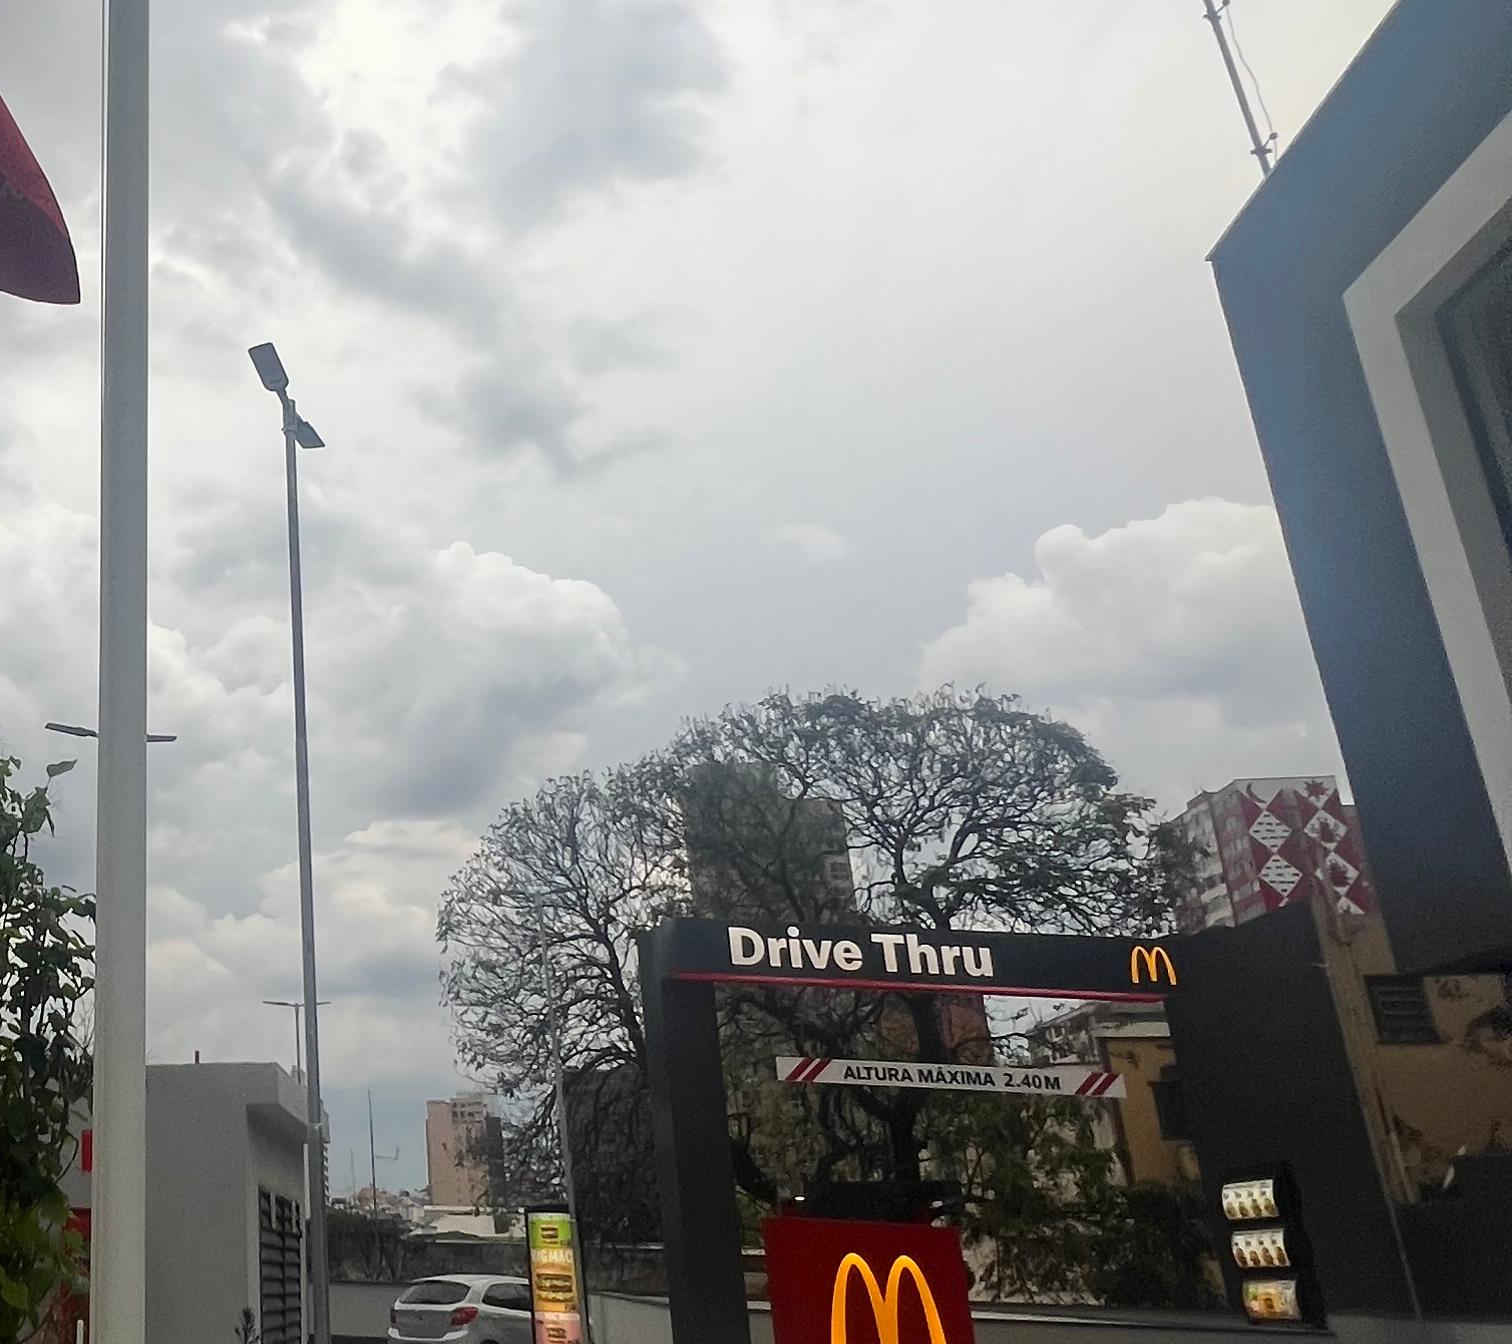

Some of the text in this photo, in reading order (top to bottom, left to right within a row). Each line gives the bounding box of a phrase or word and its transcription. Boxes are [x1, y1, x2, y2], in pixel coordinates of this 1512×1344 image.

[727, 925, 994, 978] Drive Thru
[843, 1065, 914, 1083] ALTURA
[917, 1066, 996, 1087] MÁXIMA
